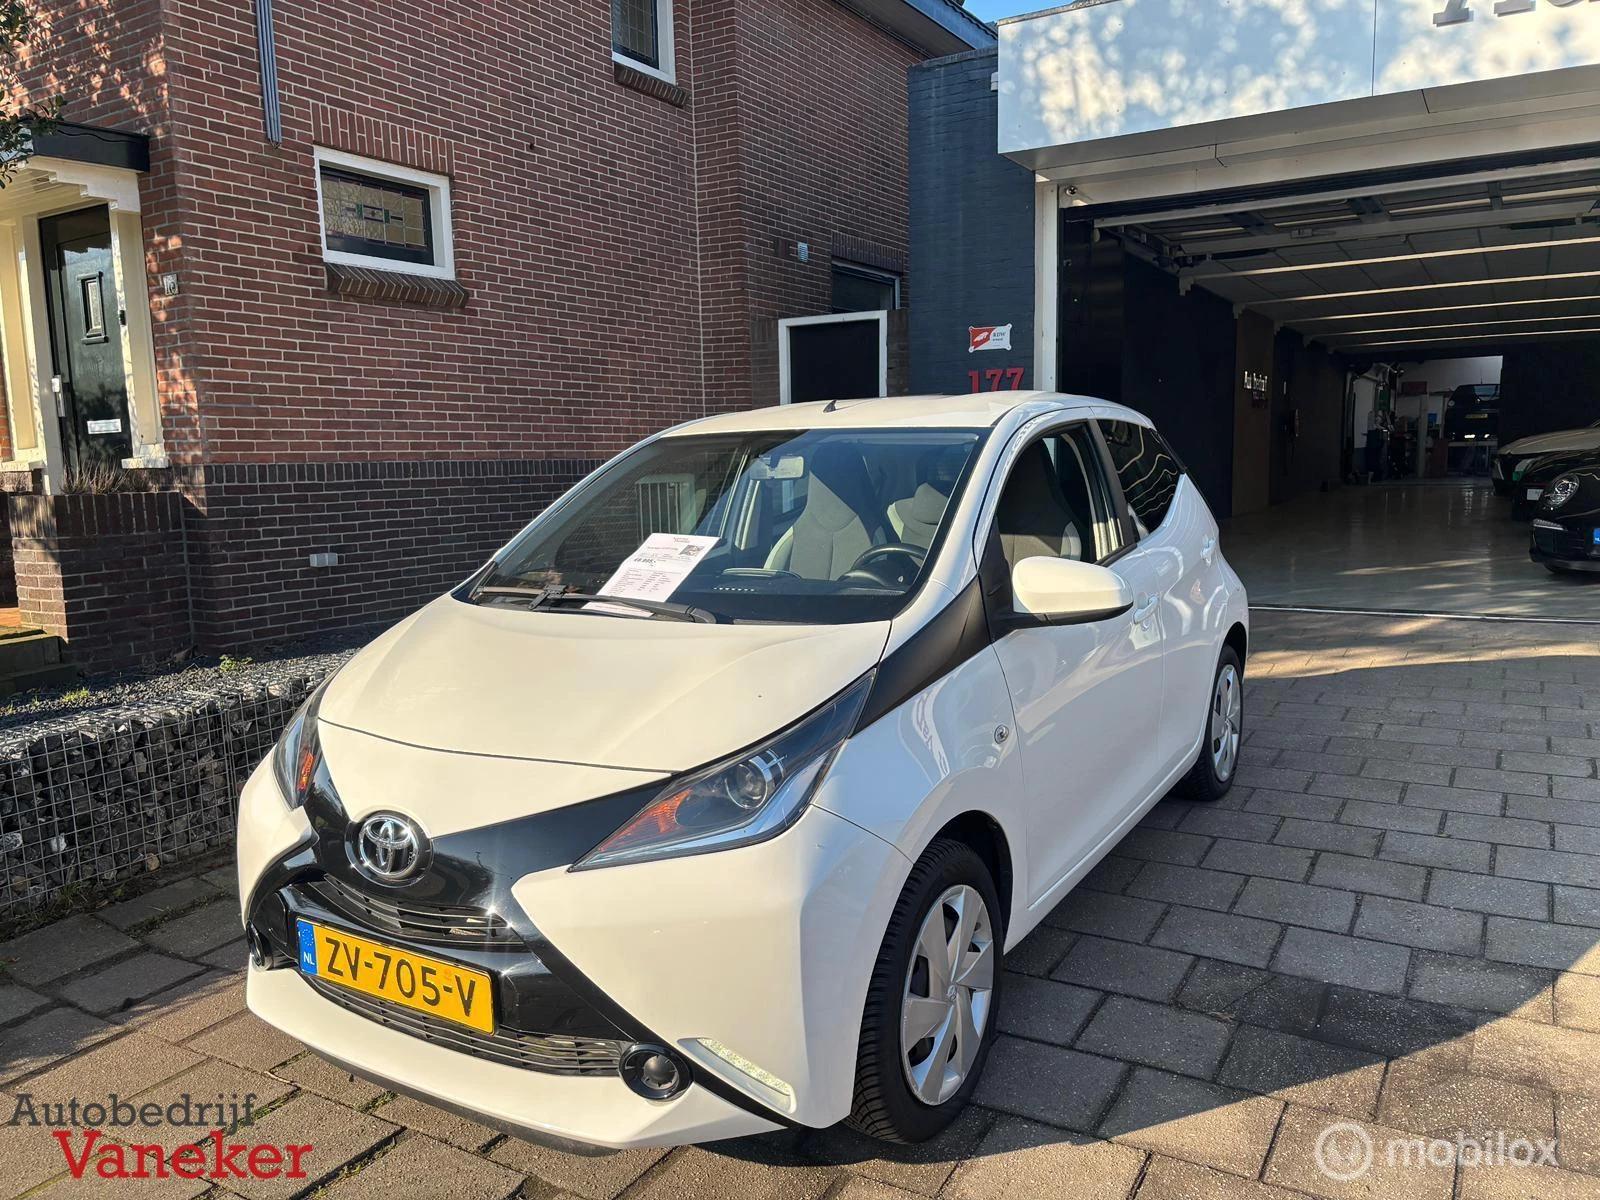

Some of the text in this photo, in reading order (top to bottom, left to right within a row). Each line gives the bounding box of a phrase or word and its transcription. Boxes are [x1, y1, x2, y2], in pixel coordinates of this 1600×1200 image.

[968, 366, 1025, 394] 177
[303, 951, 315, 966] NL
[325, 936, 476, 1017] ZV-705-V
